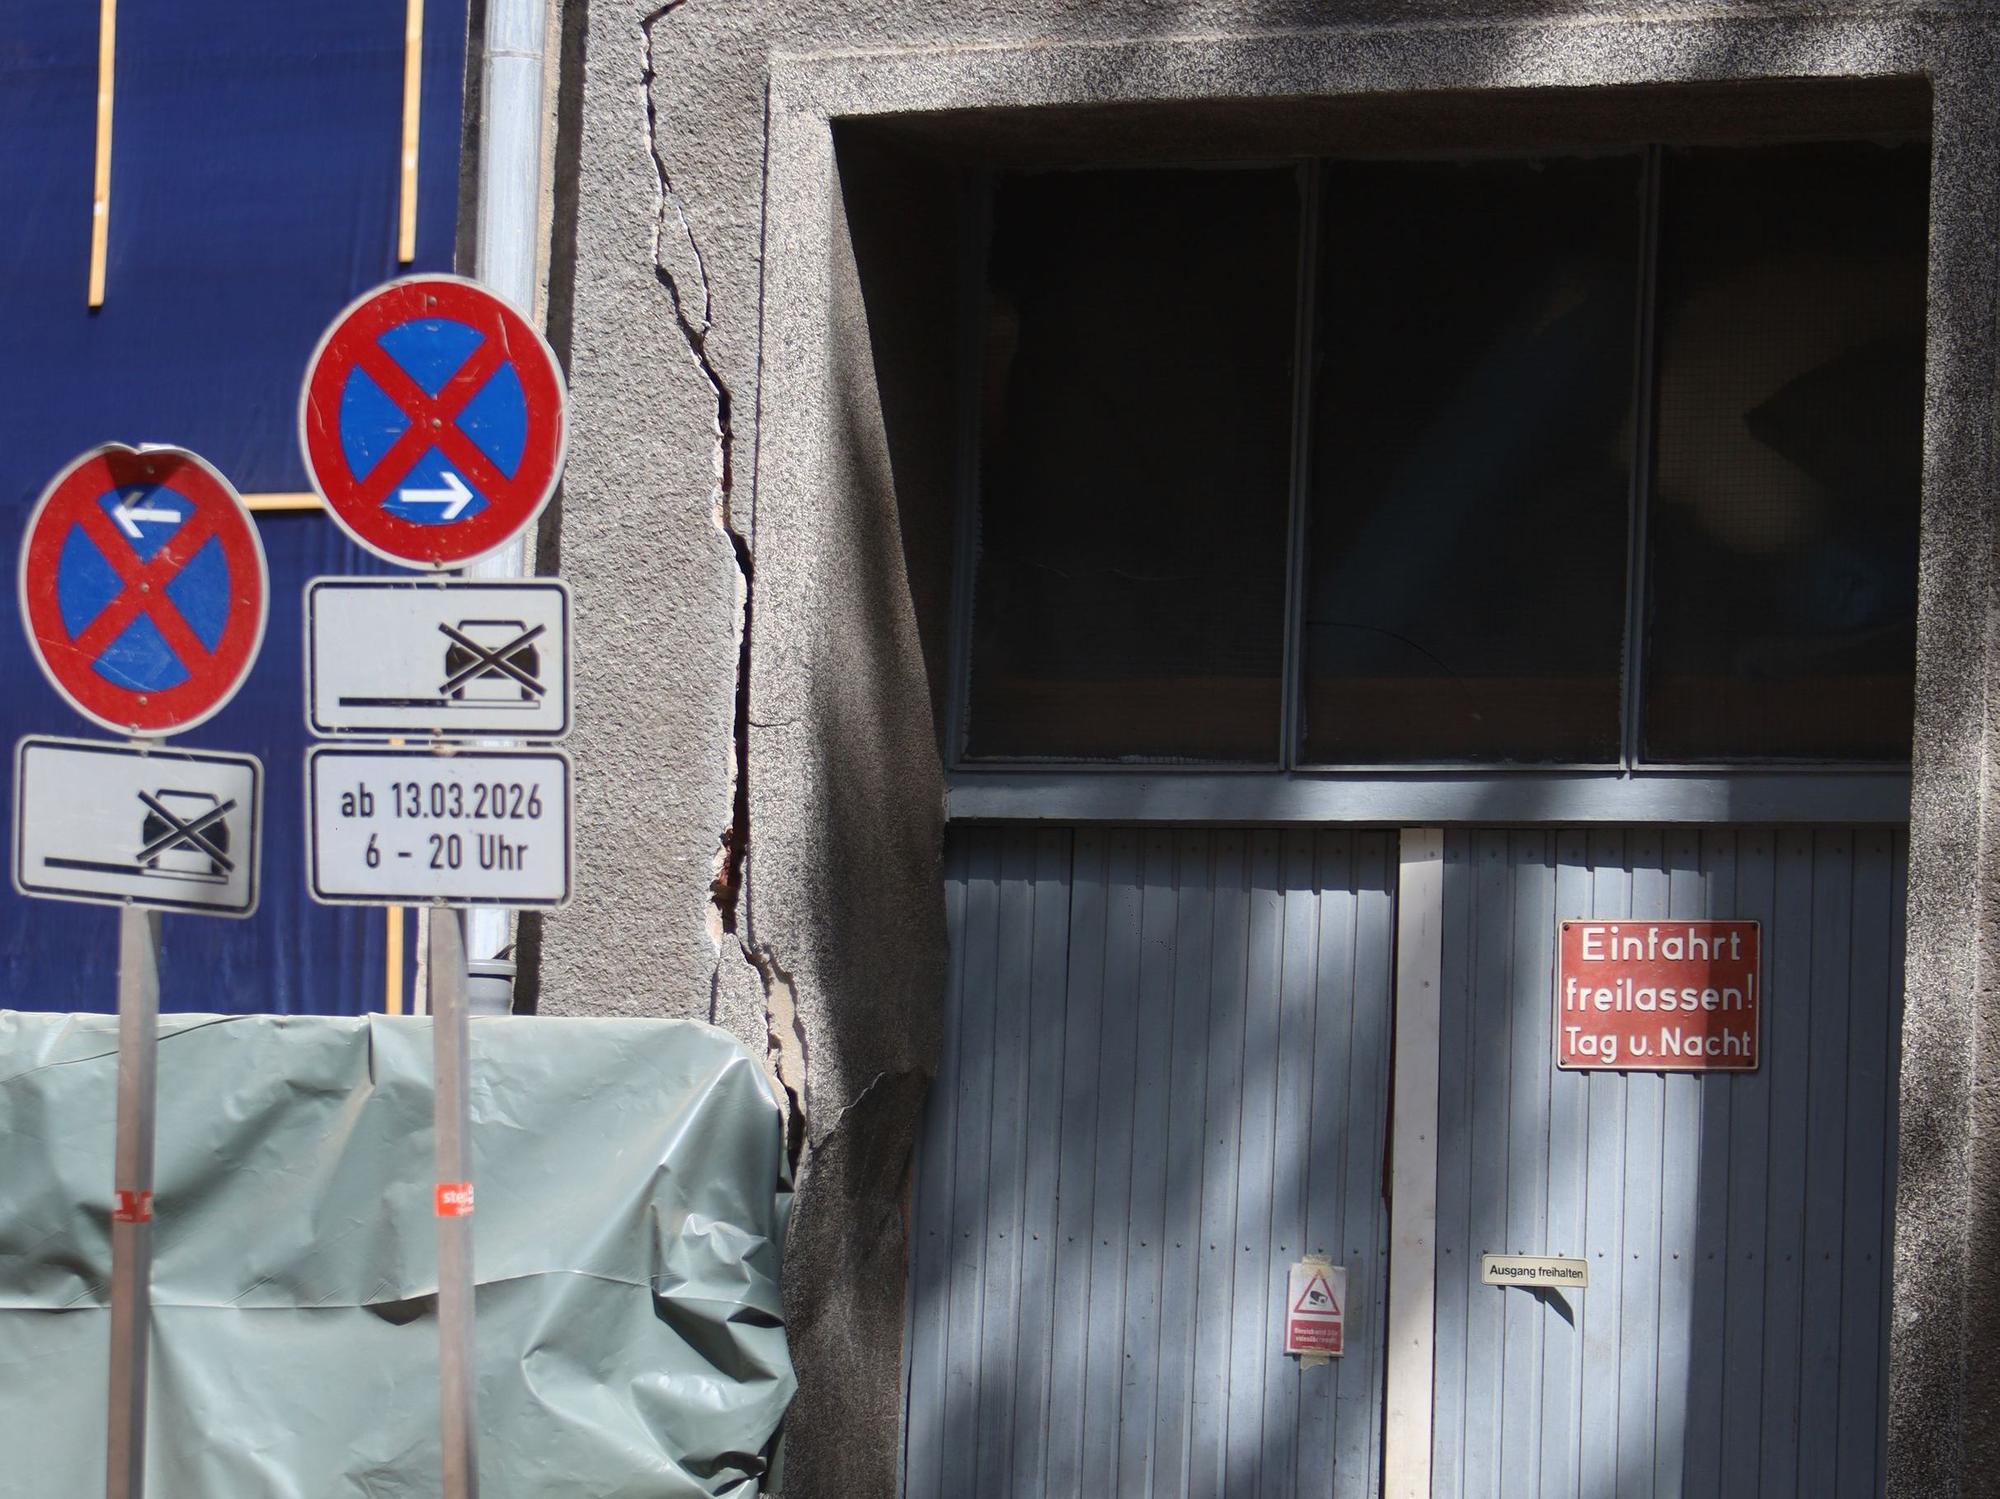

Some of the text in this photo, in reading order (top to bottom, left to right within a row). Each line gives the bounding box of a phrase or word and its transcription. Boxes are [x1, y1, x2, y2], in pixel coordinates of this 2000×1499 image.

[341, 781, 543, 819] ab 13.03.2026
[365, 833, 381, 868] 6
[429, 834, 463, 869] 20
[478, 833, 528, 870] Uhr
[1582, 926, 1741, 961] Einfahrt
[1566, 973, 1753, 1011] freilassen!
[1565, 1026, 1751, 1064] Tag u. Nacht
[1490, 1265, 1583, 1279] Ausgang freihalten
